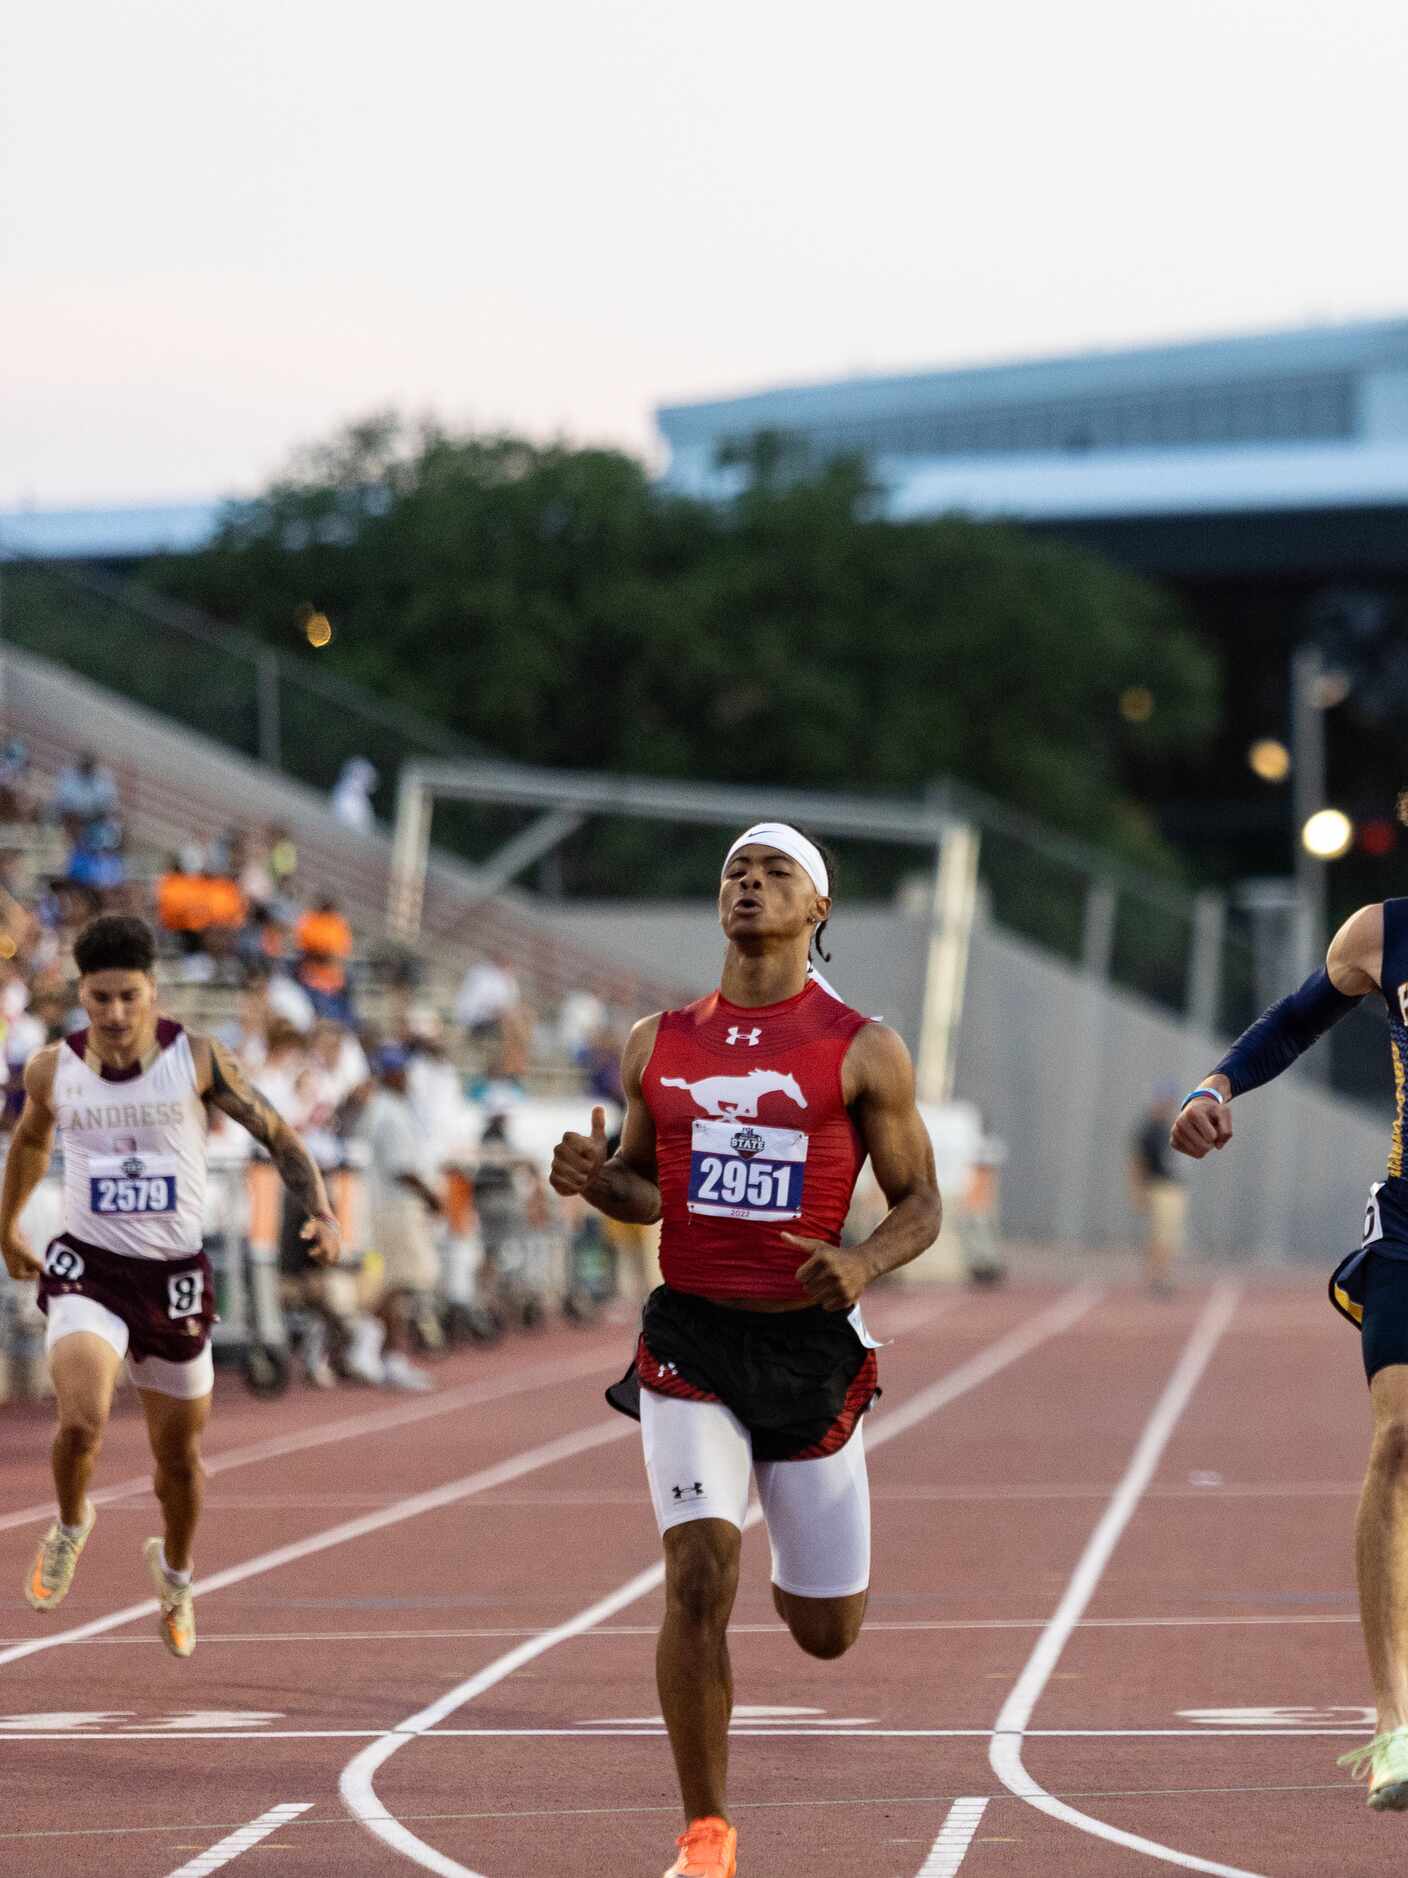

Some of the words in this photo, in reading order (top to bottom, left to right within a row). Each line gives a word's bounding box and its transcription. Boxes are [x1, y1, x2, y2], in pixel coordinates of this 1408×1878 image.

[71, 1103, 185, 1130] ANDRESS
[730, 1137, 765, 1150] STATE
[97, 1179, 169, 1212] 2579
[697, 1157, 792, 1207] 2951
